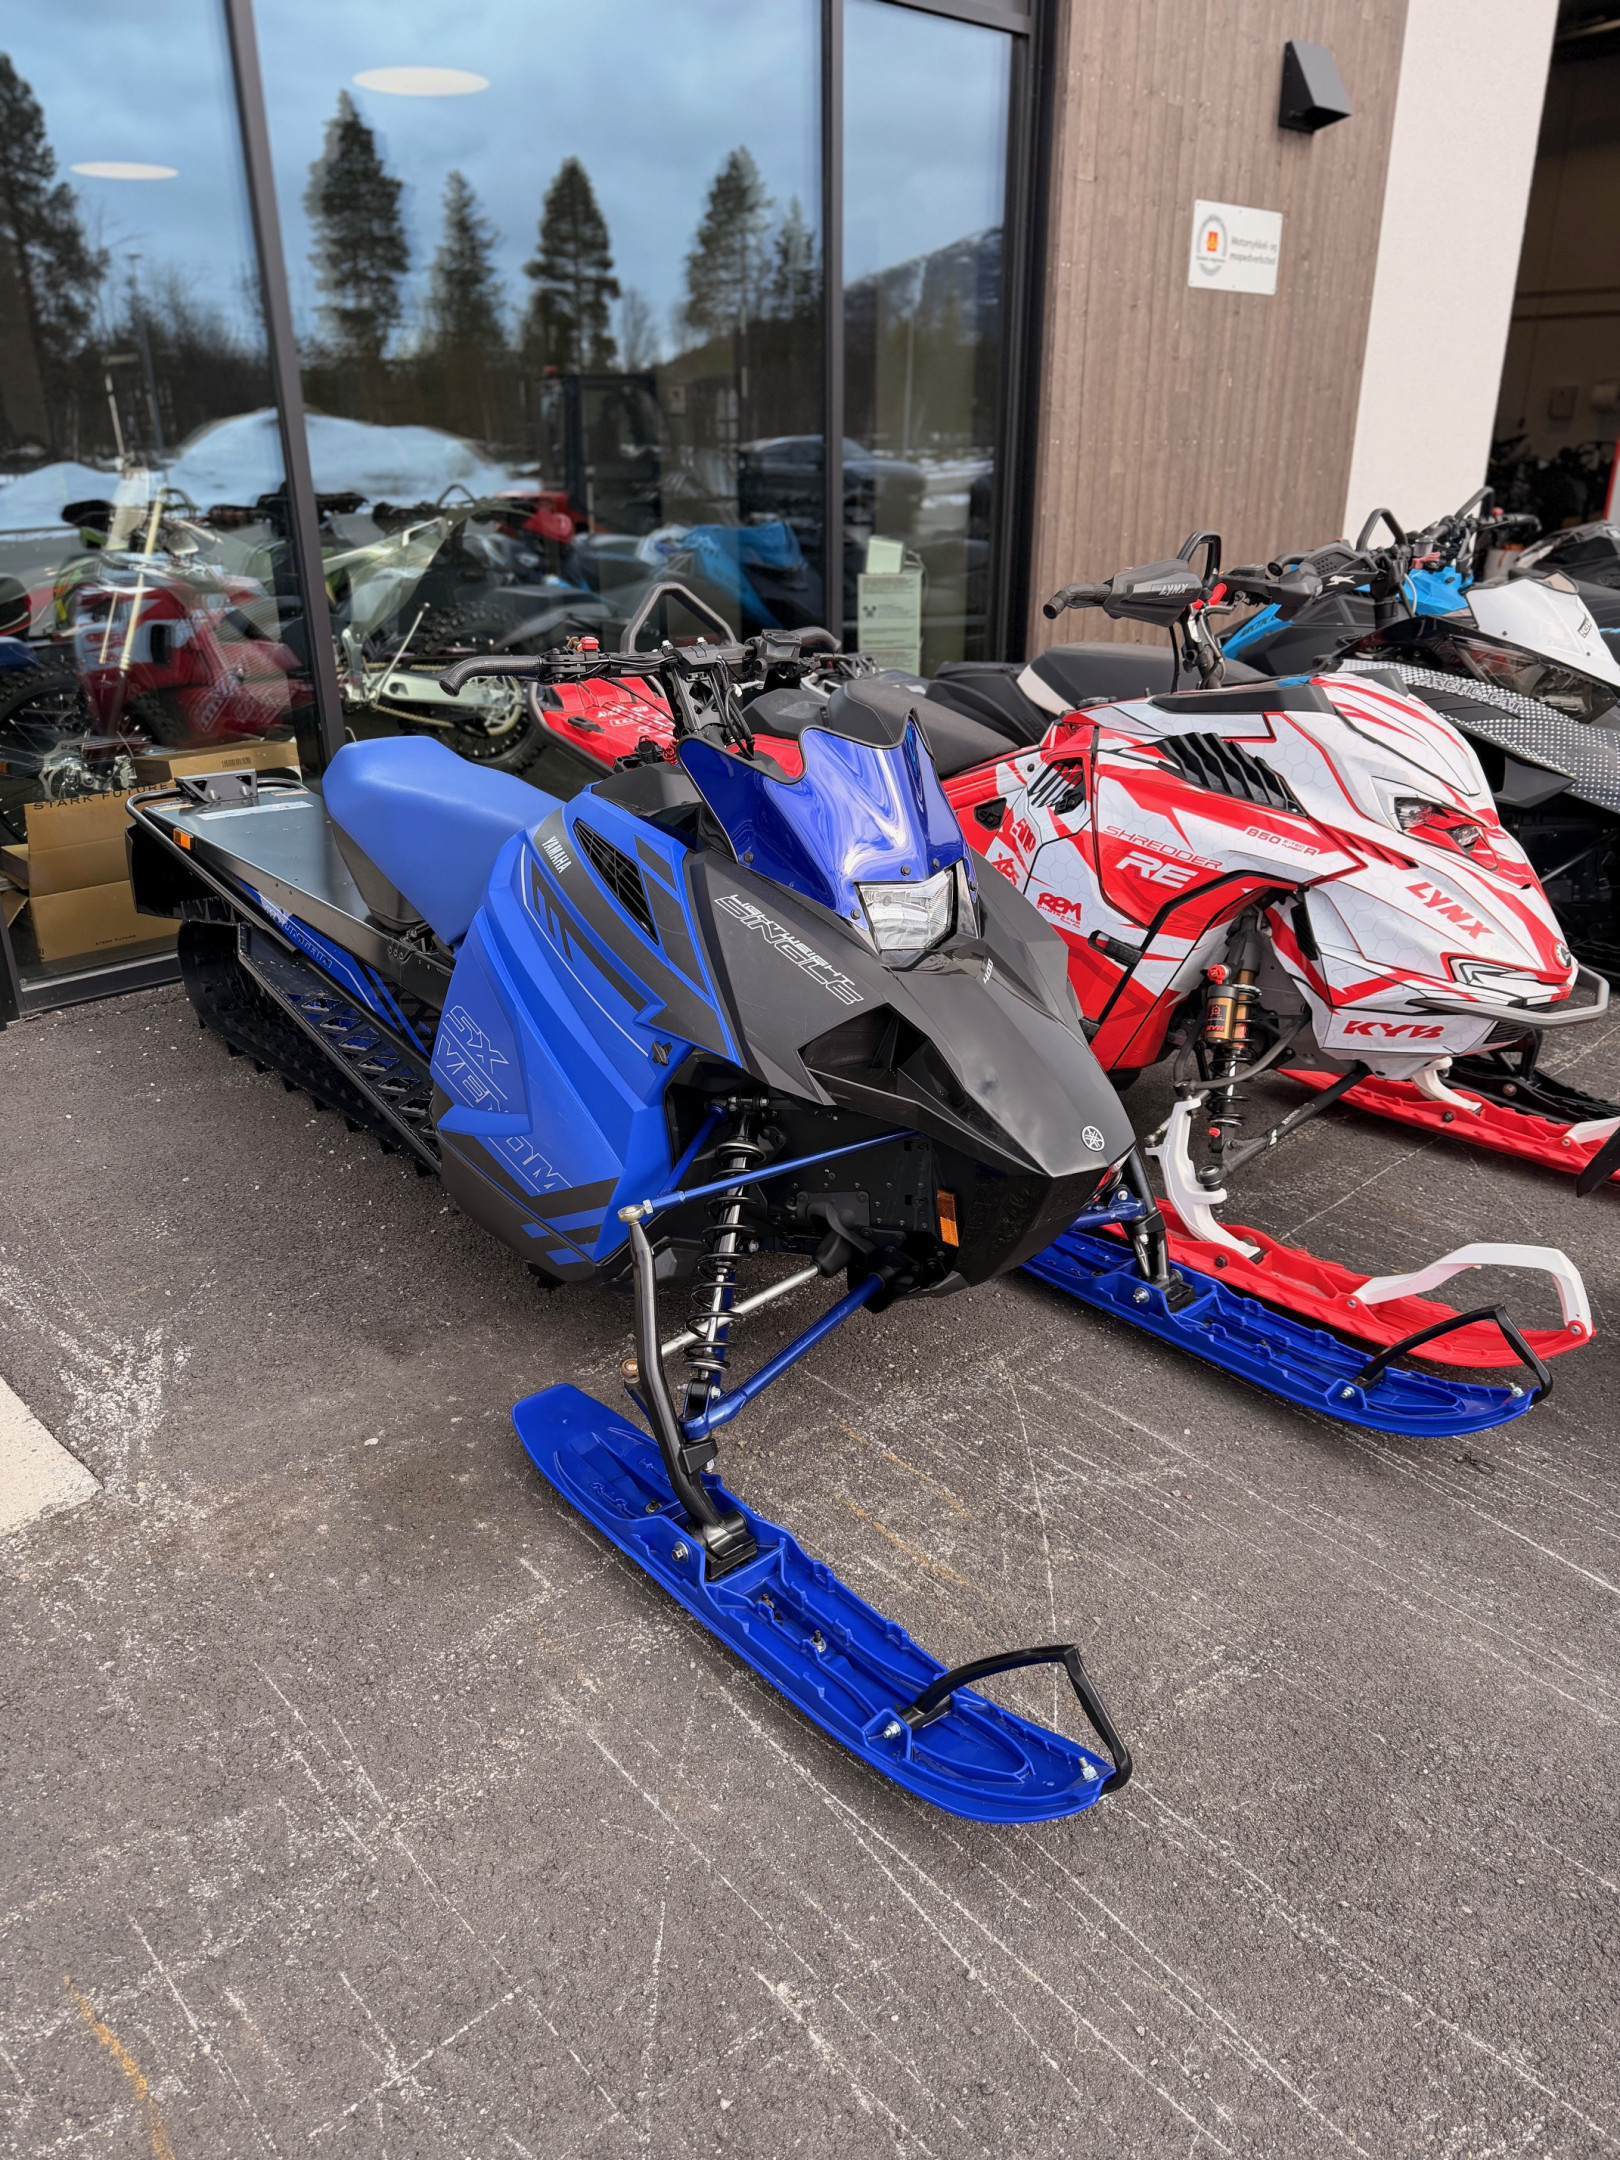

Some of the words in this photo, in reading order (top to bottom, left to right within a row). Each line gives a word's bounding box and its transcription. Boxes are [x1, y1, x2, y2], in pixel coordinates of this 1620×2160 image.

[1159, 583, 1189, 596] LYNX
[1418, 674, 1485, 701] ARCTIC
[1487, 689, 1525, 714] CAT
[33, 797, 93, 810] STARK
[102, 783, 169, 800] FUTURE
[542, 835, 572, 874] YAMAHA
[1103, 825, 1223, 869] SHREDDER
[1246, 827, 1282, 844] 850
[1115, 851, 1199, 889] RE
[1404, 881, 1495, 940] LYNX
[714, 895, 864, 1005] SINGLE
[730, 894, 855, 986] LIGHTWEIGHT
[983, 957, 994, 984] 400
[446, 1005, 509, 1074] SX
[1342, 1020, 1445, 1039] KYB
